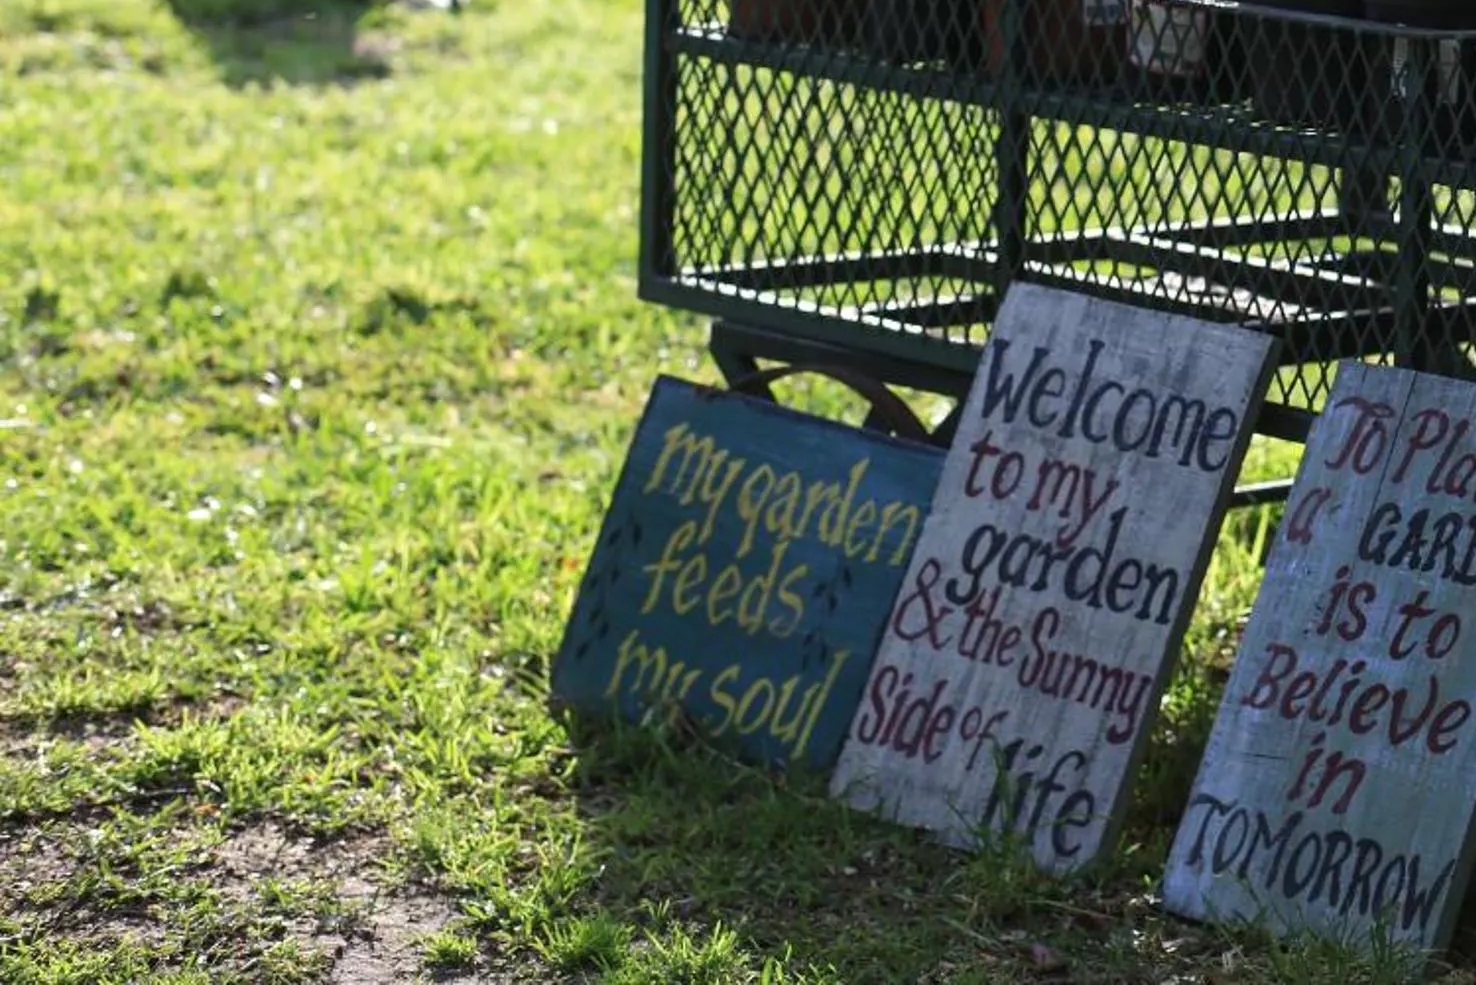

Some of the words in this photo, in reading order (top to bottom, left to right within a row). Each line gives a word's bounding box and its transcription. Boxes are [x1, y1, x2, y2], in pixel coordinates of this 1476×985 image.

[981, 339, 1236, 473] Welcome
[644, 422, 745, 544] my
[737, 457, 920, 566] garden
[965, 431, 1024, 500] to
[1026, 455, 1118, 547] my
[641, 521, 808, 637] feeds
[945, 506, 1180, 625] garden
[1316, 565, 1376, 641] is
[1389, 591, 1462, 660] to
[711, 650, 850, 759] soul
[858, 665, 955, 764] Side
[1018, 607, 1151, 744] Sunny
[1242, 643, 1472, 753] Believe
[1288, 733, 1366, 814] in
[1186, 793, 1455, 930] TOMORROW
